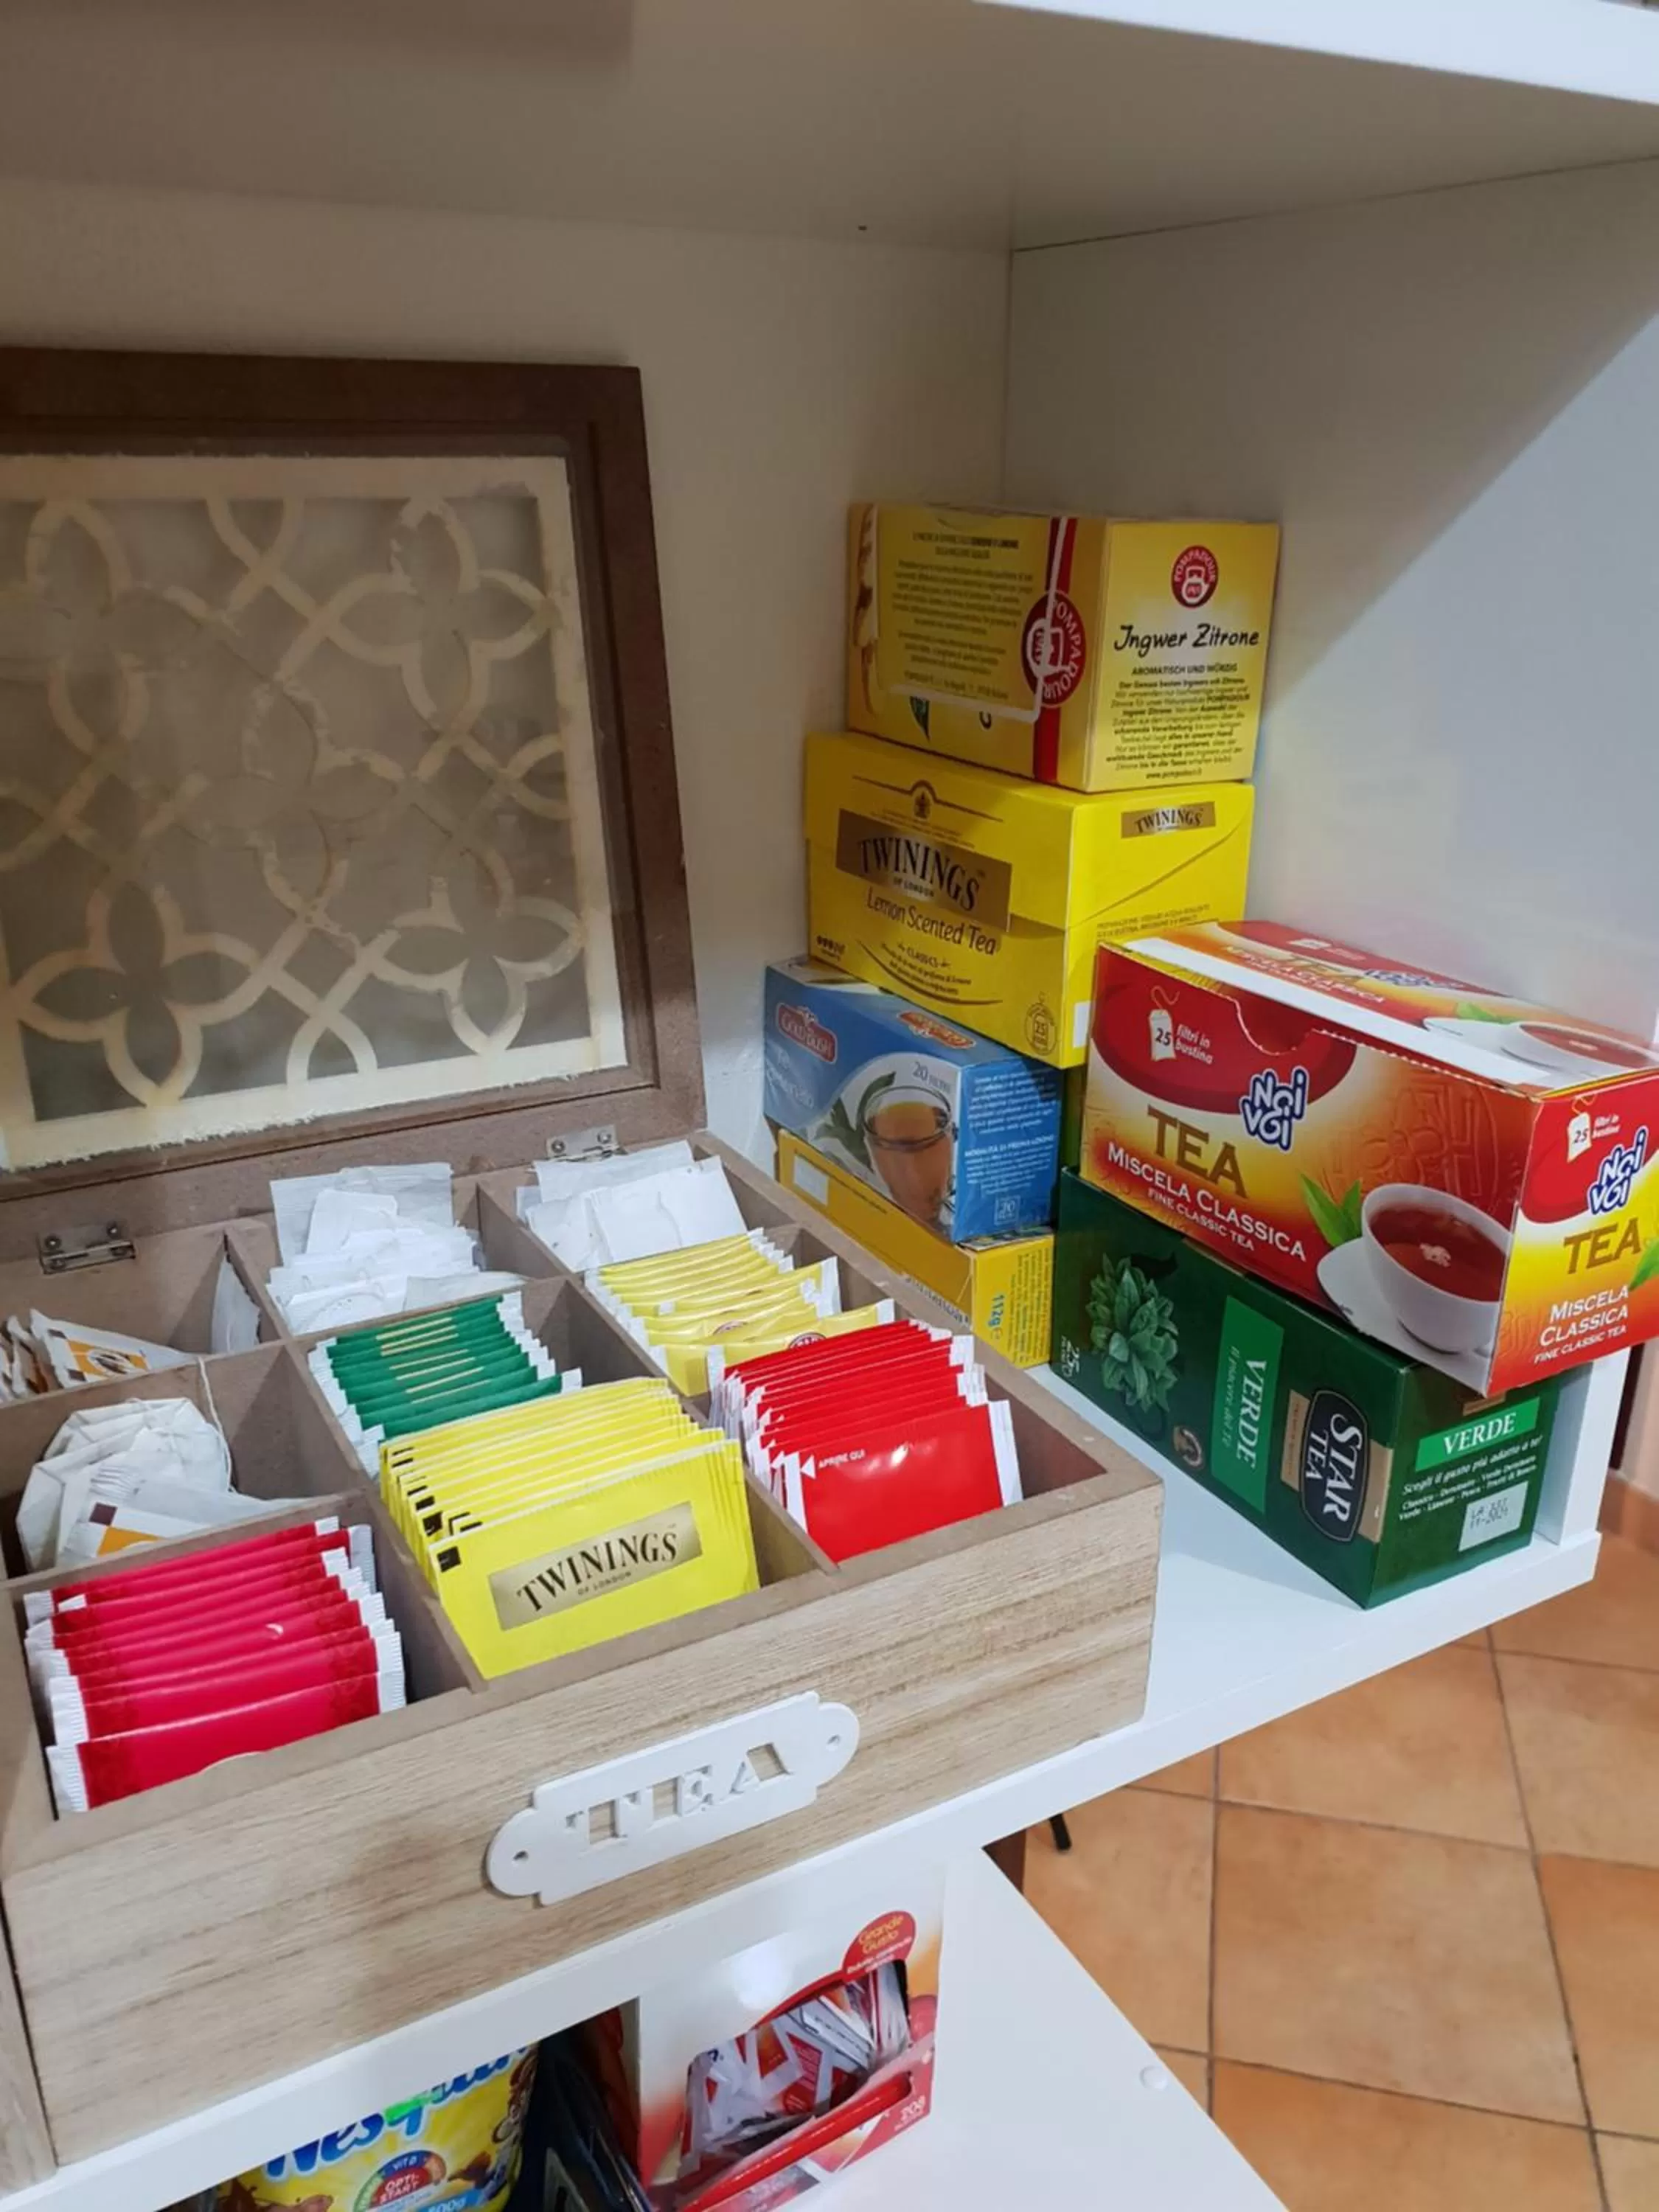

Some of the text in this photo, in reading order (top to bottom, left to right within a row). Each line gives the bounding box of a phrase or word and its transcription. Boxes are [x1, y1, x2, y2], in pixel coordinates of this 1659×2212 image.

[1043, 599, 1082, 700] OMPADOUR
[1192, 623, 1259, 647] Zitrone
[1186, 664, 1205, 674] UND
[1134, 807, 1203, 834] TWININGS
[858, 837, 980, 911] TWININGS
[867, 886, 996, 956] Lemon Scented Tea
[1155, 1023, 1211, 1049] 25 filtri in
[1175, 1040, 1214, 1065] bustina
[912, 1061, 928, 1081] 20
[1147, 1104, 1248, 1198] TEA
[1573, 1128, 1587, 1144] 25
[1147, 1188, 1254, 1251] FINE CLASSIC TEA
[1196, 1189, 1307, 1262] CLASSICA
[1563, 1217, 1642, 1275] TEA
[1534, 1325, 1627, 1364] FINE CLASSIC TEA
[1539, 1304, 1630, 1348] CLASSICA
[1236, 1360, 1267, 1470] VERDE
[1443, 1411, 1517, 1455] VERDE
[1306, 1429, 1329, 1481] TEA
[1323, 1413, 1363, 1523] STAR
[516, 1531, 678, 1613] TWININGS
[577, 1571, 633, 1596] OF LONDON
[565, 1742, 795, 1857] TEA
[263, 2047, 529, 2179] Nesq
